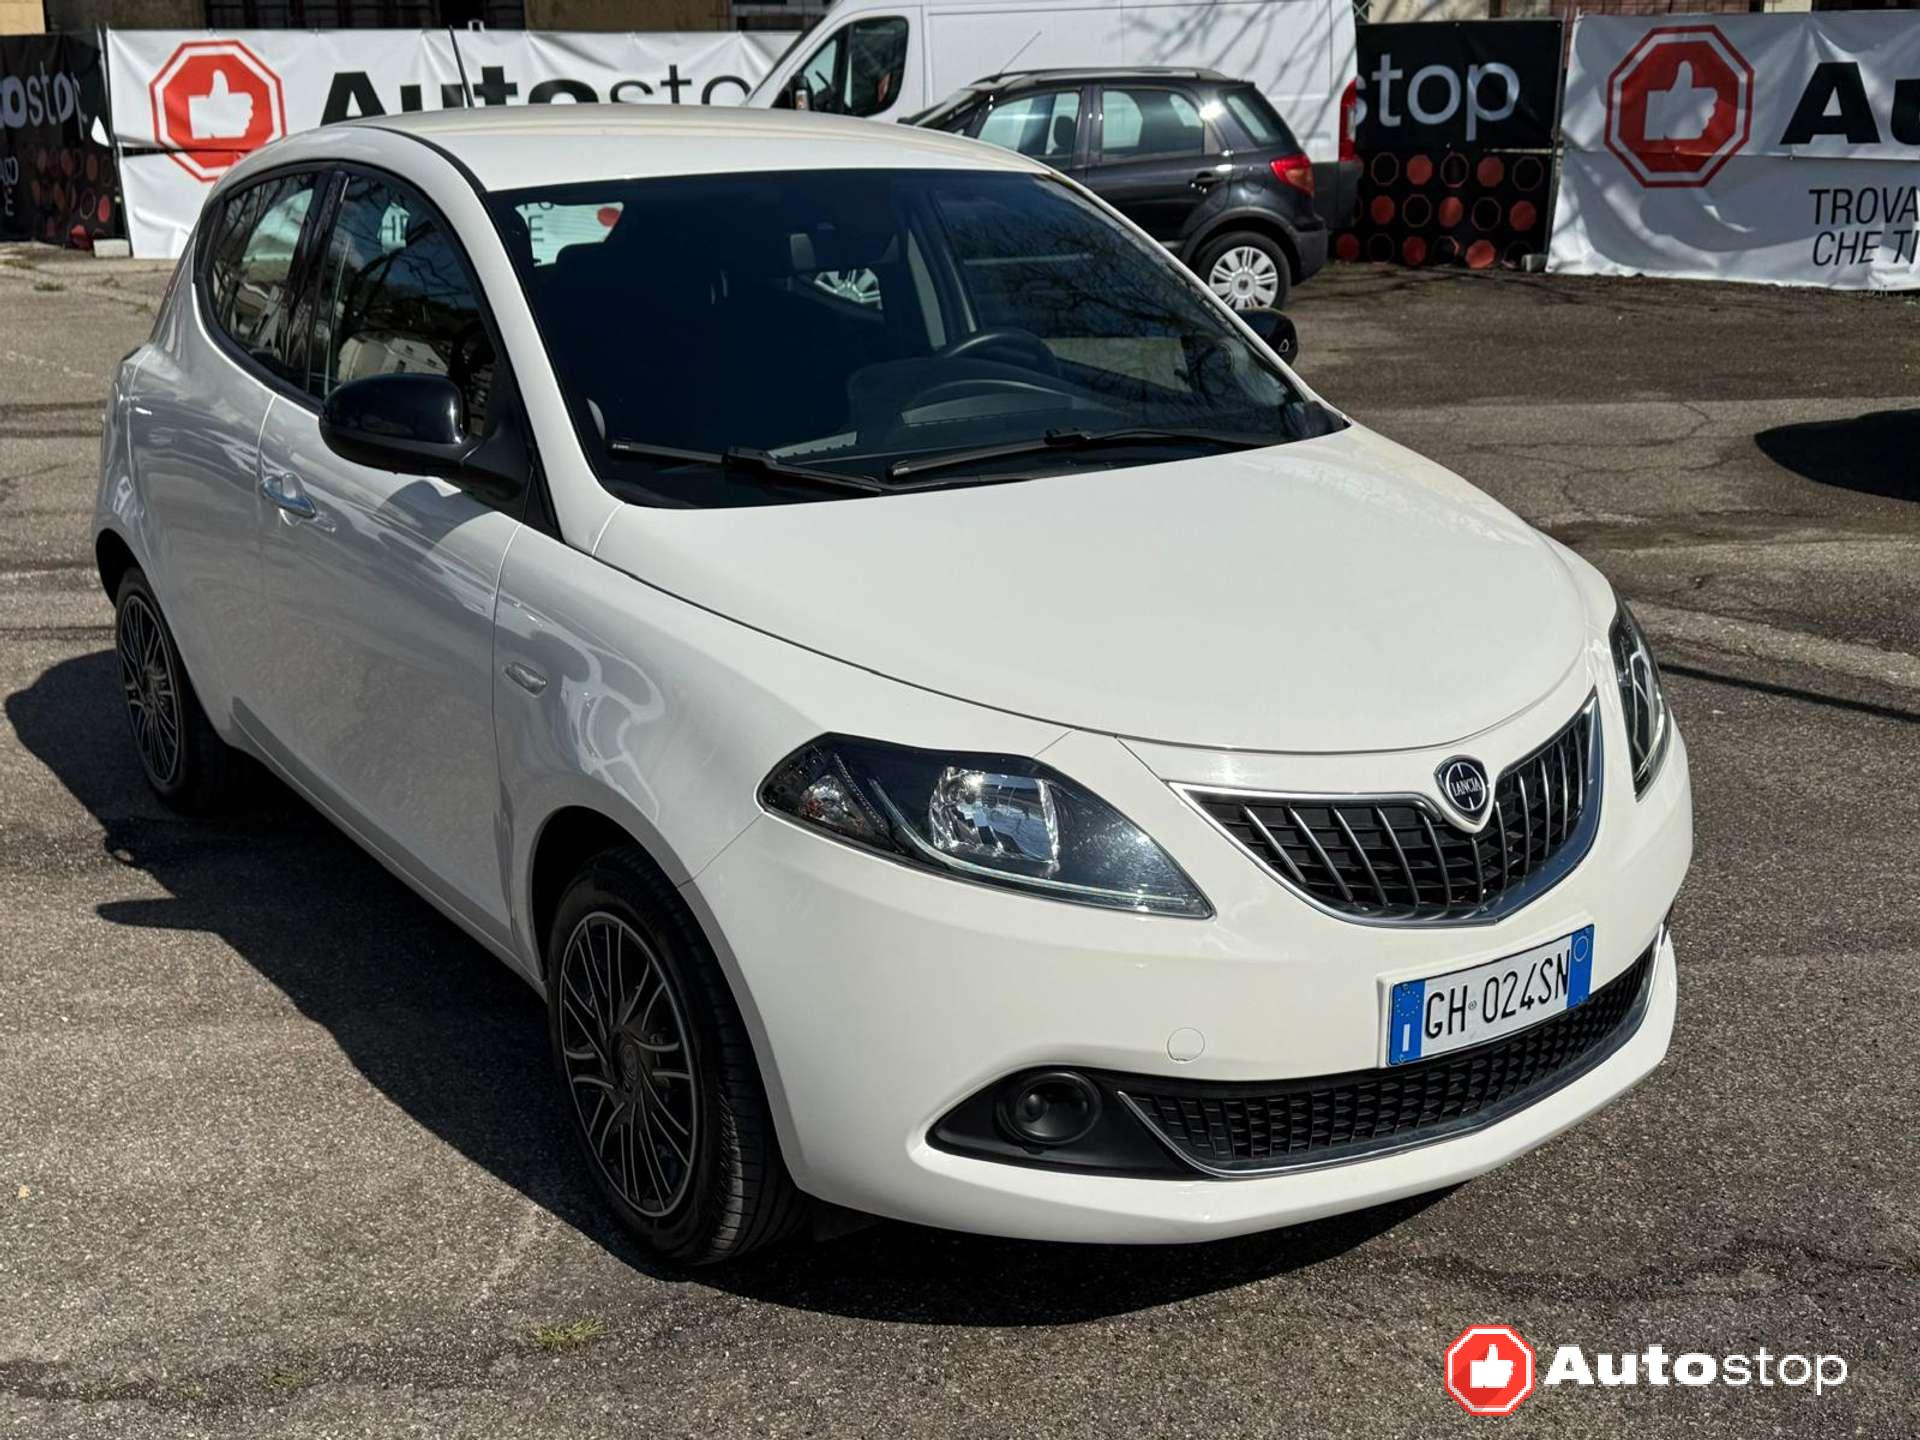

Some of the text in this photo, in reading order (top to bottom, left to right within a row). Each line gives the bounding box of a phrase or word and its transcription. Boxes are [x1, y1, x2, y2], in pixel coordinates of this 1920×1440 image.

[1356, 53, 1520, 142] top
[1808, 186, 1919, 225] TROVA
[1812, 230, 1919, 266] CHE TI
